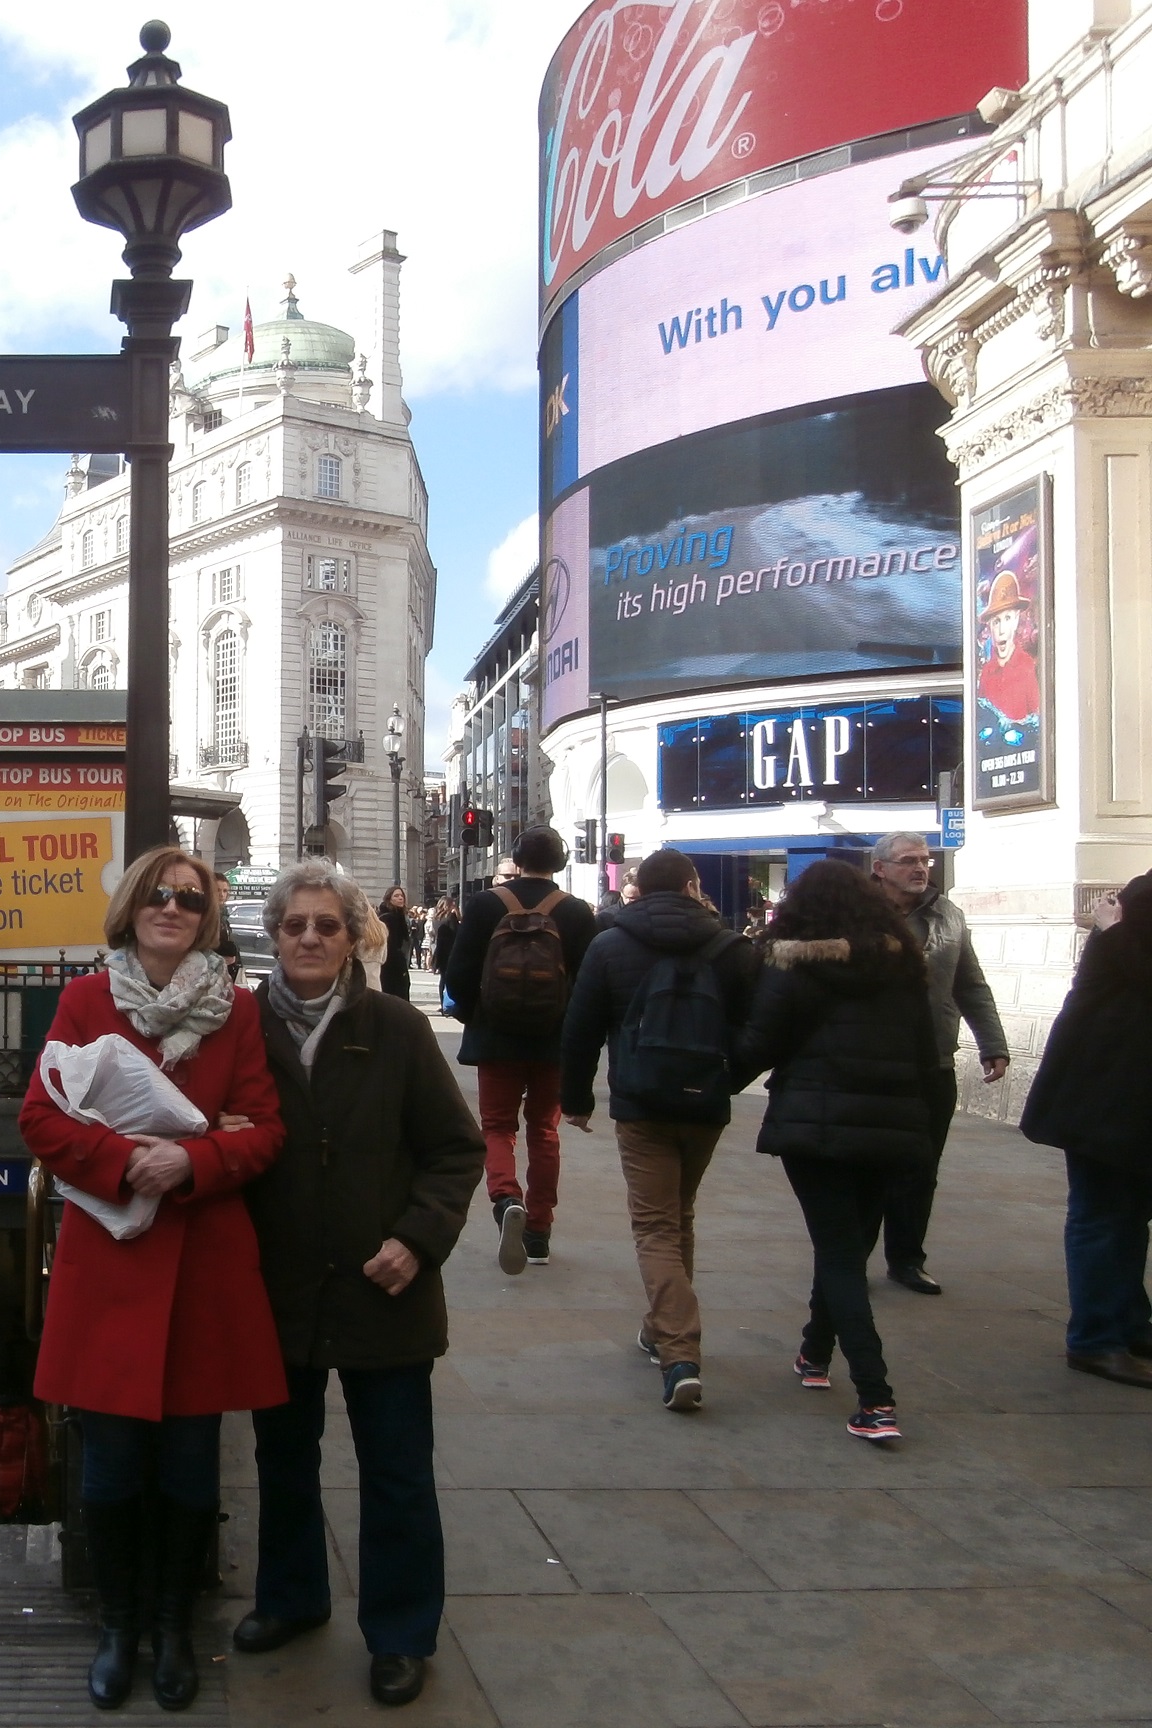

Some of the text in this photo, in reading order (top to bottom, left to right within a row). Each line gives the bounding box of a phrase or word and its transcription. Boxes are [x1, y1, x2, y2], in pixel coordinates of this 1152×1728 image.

[658, 297, 742, 355] With
[760, 275, 846, 332] you
[604, 524, 734, 586] Proving
[616, 543, 957, 620] its high performance
[29, 728, 66, 743] BUS
[753, 716, 849, 790] GAP
[38, 768, 72, 784] BUS
[78, 768, 123, 784] TOUR
[4, 796, 22, 807] on
[27, 793, 52, 807] The
[57, 791, 124, 809] Original!
[22, 832, 99, 862] TOUR
[11, 867, 84, 895] ticket
